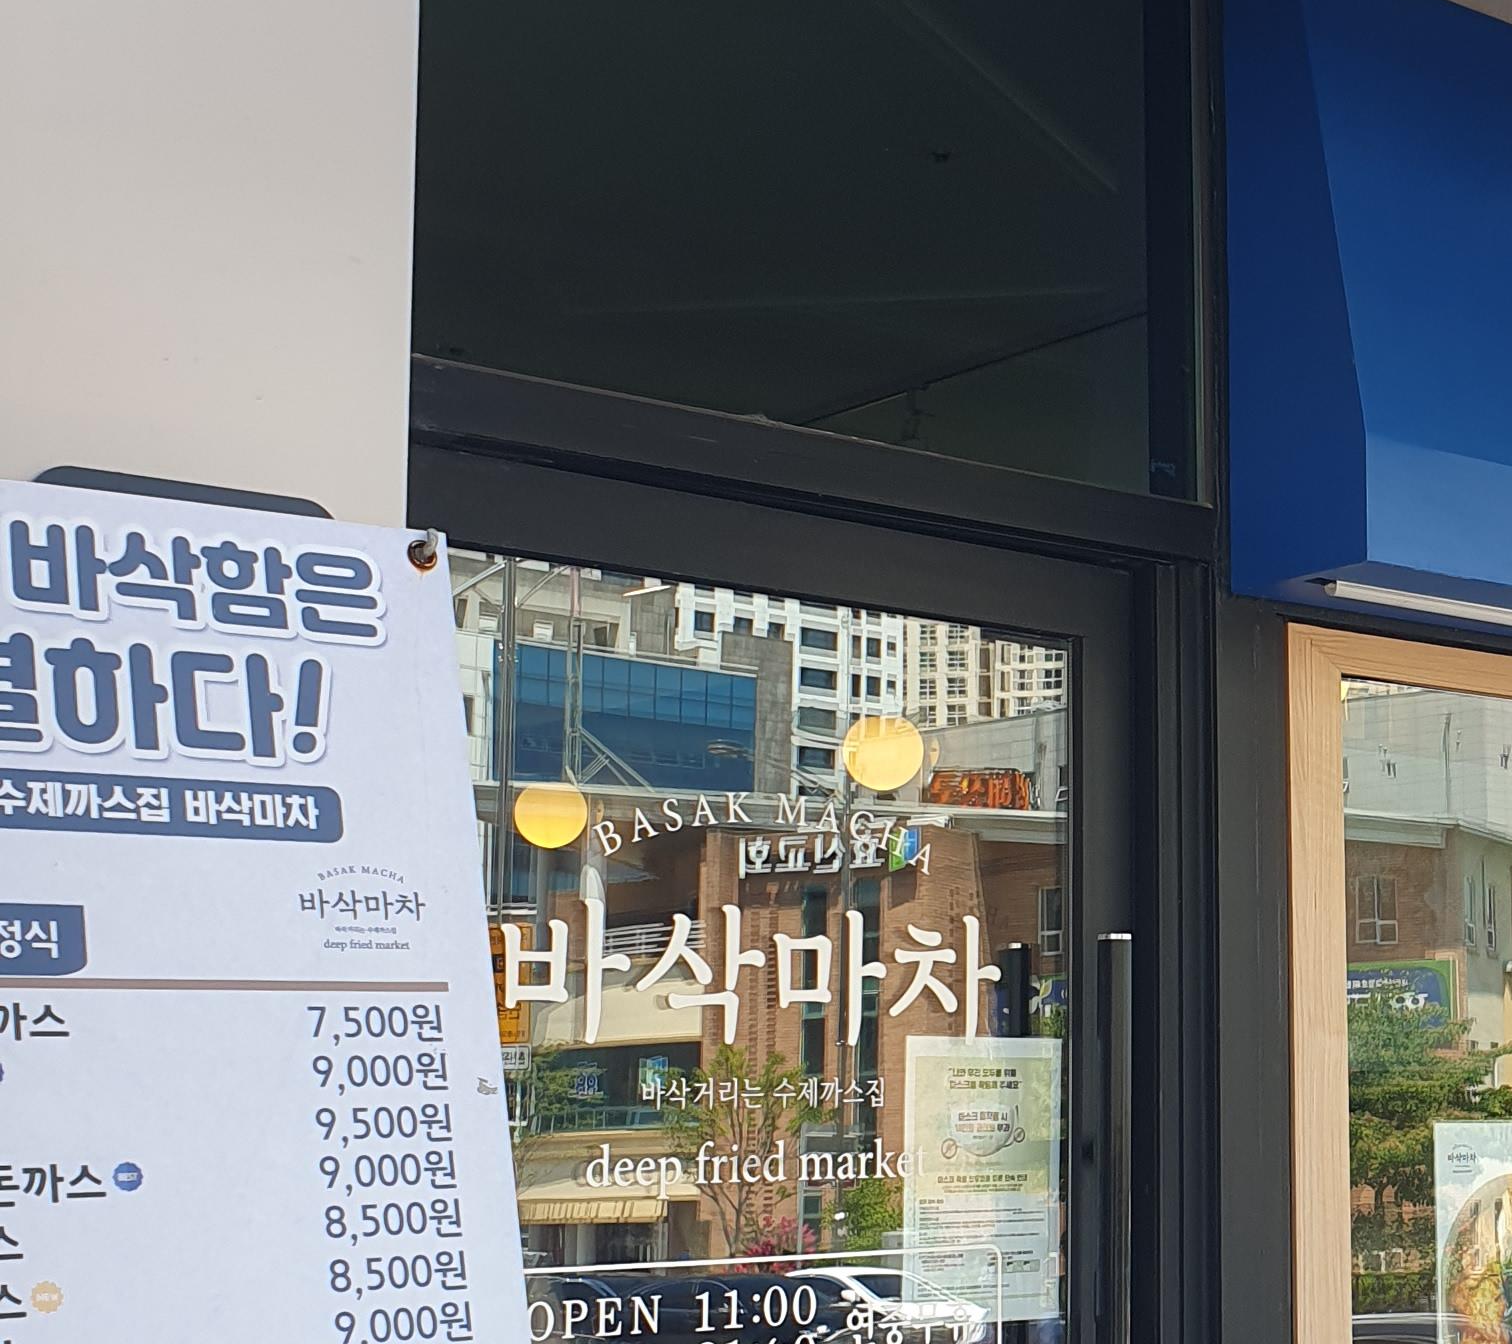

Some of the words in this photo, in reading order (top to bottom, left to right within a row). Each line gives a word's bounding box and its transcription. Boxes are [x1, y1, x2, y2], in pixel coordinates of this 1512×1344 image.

[8, 519, 381, 639] 바삭함은
[184, 789, 320, 830] 바삭마차
[593, 792, 753, 856] BASAK
[776, 792, 933, 876] MACHA
[317, 865, 357, 881] BASAK
[361, 865, 405, 884] MACHA
[298, 888, 426, 921] 바삭마차
[323, 939, 347, 952] deep
[350, 939, 373, 950] fried
[375, 940, 410, 950] market
[500, 899, 1001, 1046] 바삭마차
[306, 1005, 444, 1045] 7,500원
[311, 1052, 450, 1094] 9,000원
[641, 1076, 765, 1110] 바삭거리는
[773, 1076, 886, 1108] 수제까스집
[314, 1104, 454, 1147] 9,500원
[318, 1150, 458, 1194] 9,000원
[585, 1147, 682, 1201] deep
[695, 1142, 790, 1183] fried
[798, 1139, 928, 1182] market
[323, 1202, 464, 1246] 8,500원
[329, 1251, 469, 1299] 8,500원
[529, 1295, 661, 1343] OPEN
[694, 1285, 818, 1332] 11:00
